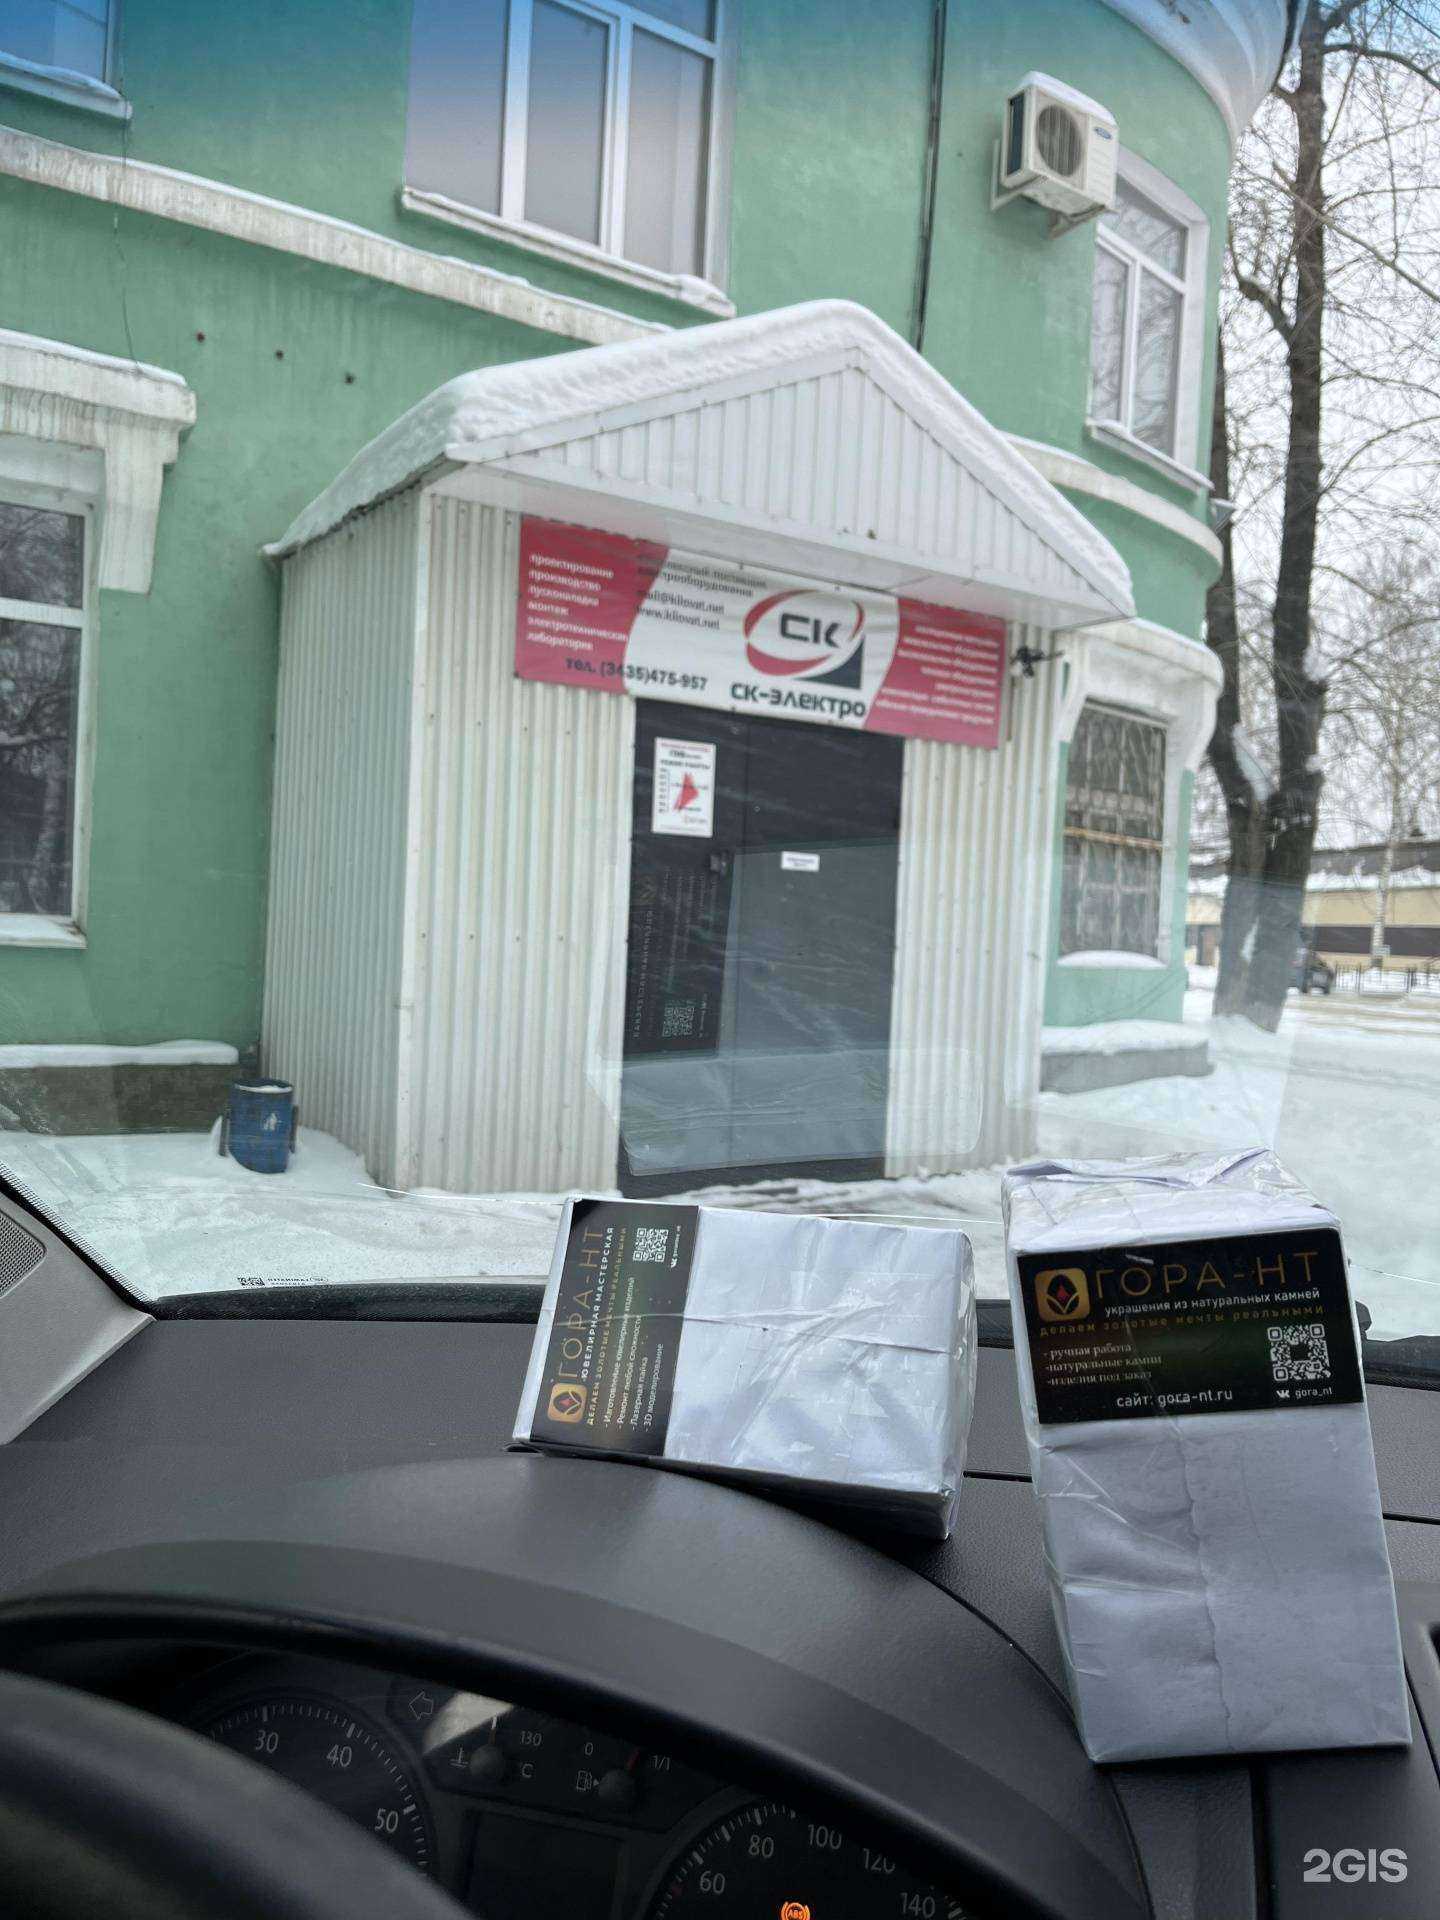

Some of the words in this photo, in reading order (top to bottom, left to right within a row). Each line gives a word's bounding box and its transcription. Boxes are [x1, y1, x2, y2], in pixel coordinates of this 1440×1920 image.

[595, 1227, 614, 1302] МАСТЕРСКАЯ
[1096, 1251, 1319, 1298] ГОРА-НТ
[1104, 1301, 1171, 1317] украшения
[1174, 1300, 1188, 1309] из
[1191, 1292, 1271, 1310] натуральных
[1274, 1287, 1320, 1300] камней
[1116, 1391, 1153, 1407] сайт:
[1158, 1389, 1233, 1407] gora-nt.ru
[255, 1730, 279, 1753] 30
[520, 1730, 542, 1746] 130
[326, 1744, 352, 1767] 40
[374, 1808, 399, 1833] 50
[750, 1835, 774, 1859] 80
[808, 1824, 842, 1849] 100
[864, 1848, 896, 1873] 120
[700, 1870, 726, 1894] 60
[901, 1892, 936, 1918] 140
